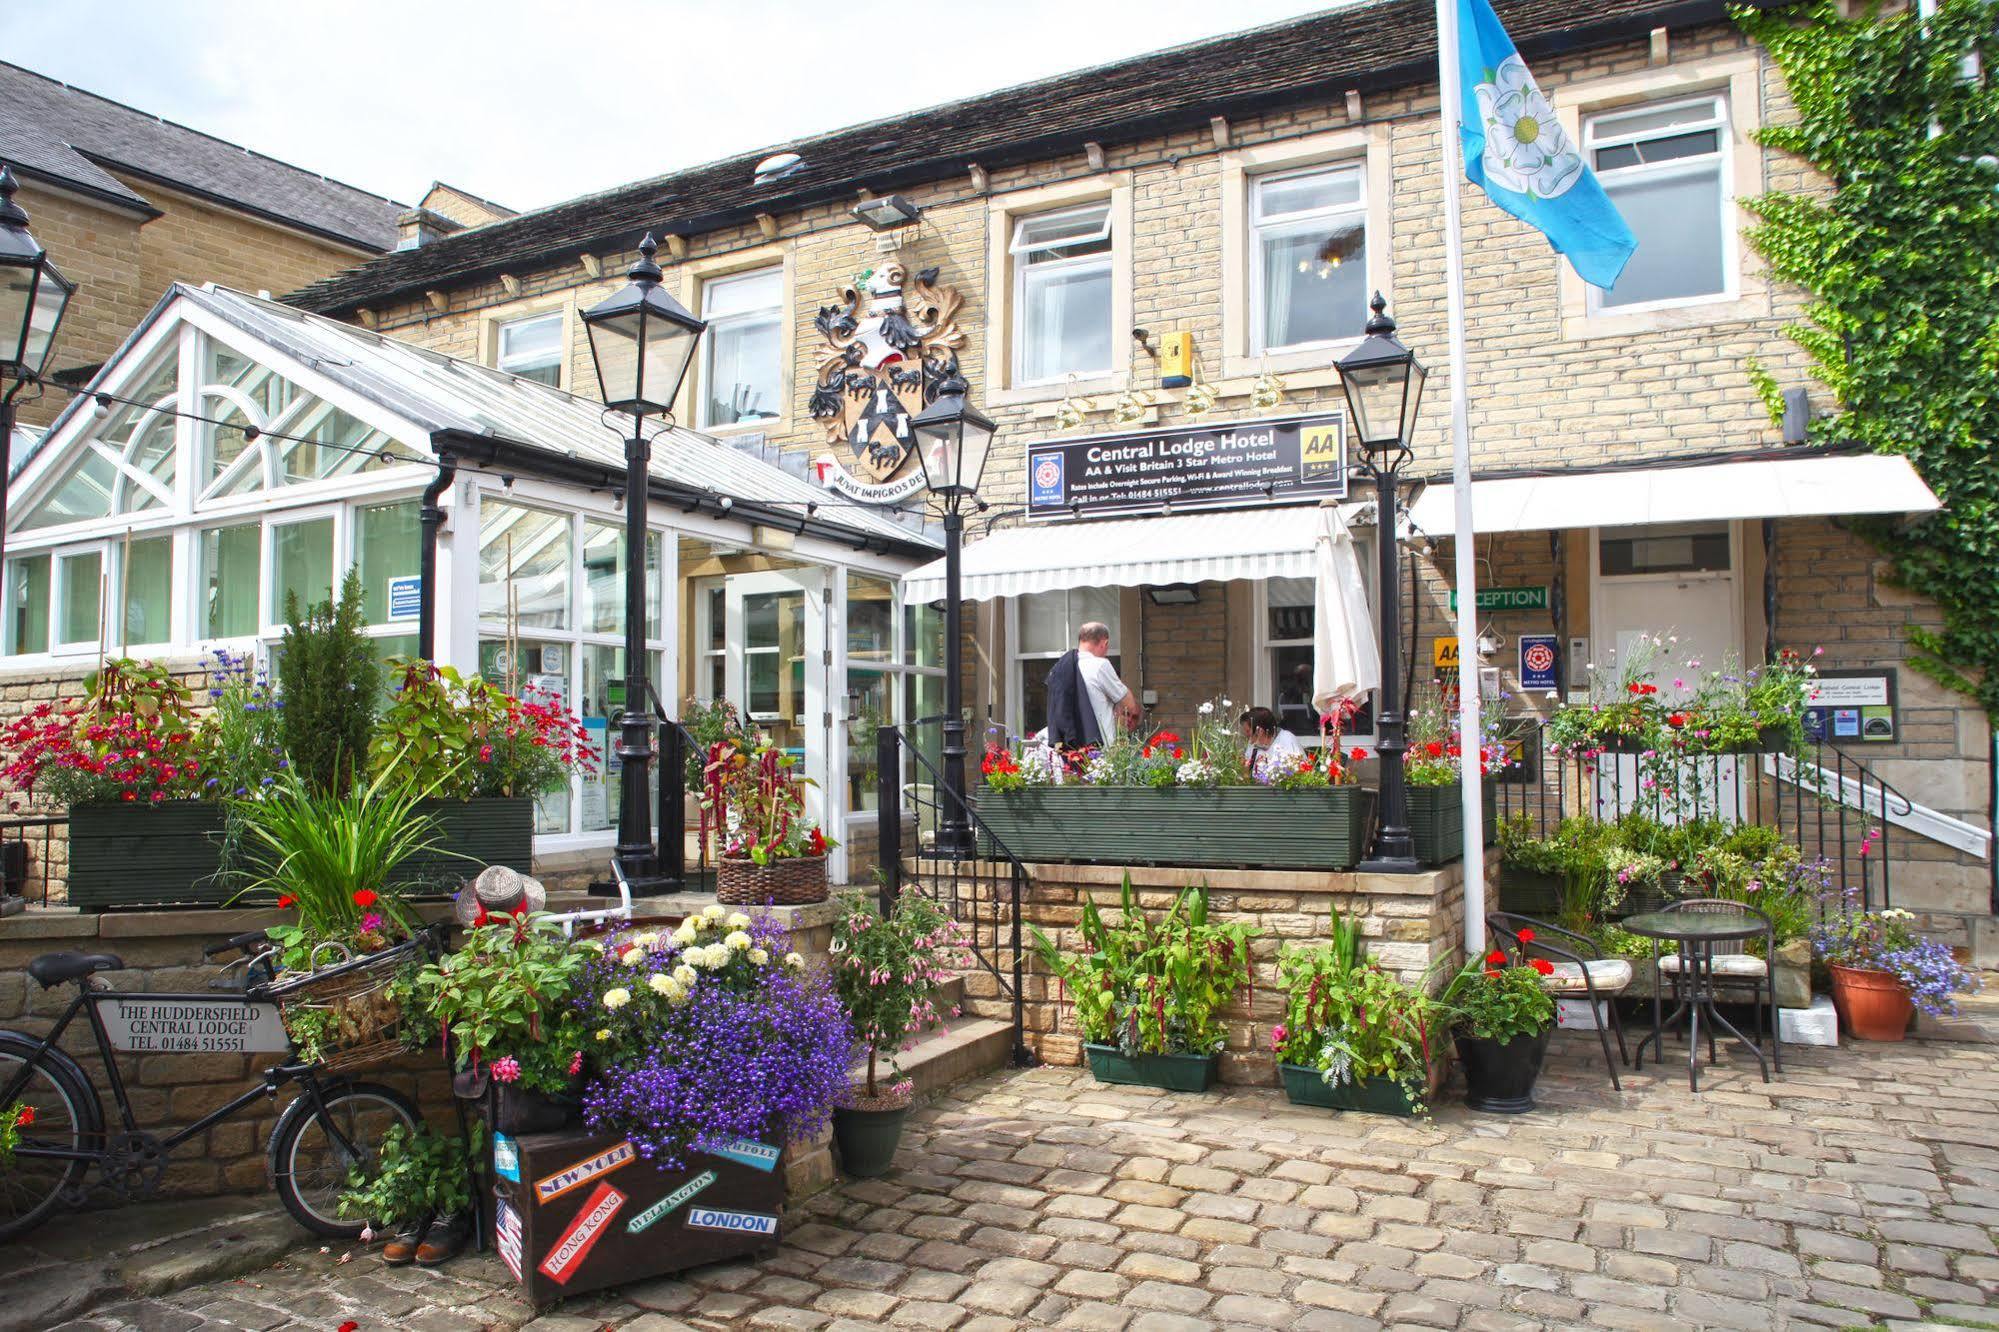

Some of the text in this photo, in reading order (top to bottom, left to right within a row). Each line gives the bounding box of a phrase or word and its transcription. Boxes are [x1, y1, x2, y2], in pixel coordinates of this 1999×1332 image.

[1087, 430, 1275, 463] Central Lodge Hotel
[1305, 434, 1333, 455] AA
[1085, 450, 1277, 477] AA & Visit Britain 3 Star Metro Hotel
[1110, 479, 1139, 488] Overnight
[1140, 477, 1161, 485] Secure
[1212, 470, 1234, 479] Award
[1235, 467, 1261, 477] Winning
[1263, 465, 1293, 475] Breakfast
[861, 483, 908, 498] IMPIGROS
[1128, 489, 1152, 499] 01484
[1155, 487, 1181, 498] 515551
[1454, 591, 1541, 606] CEPTION
[119, 1006, 260, 1021] THE HUDDERSFIELD
[130, 1021, 247, 1035] CENTRAL LODGE
[129, 1036, 245, 1051] TEL. 01484 515551
[540, 1144, 634, 1196] NEW YORK
[631, 1172, 713, 1229] WELLINGTON
[690, 1210, 769, 1232] LONDON
[548, 1193, 619, 1272] HONG KONG
